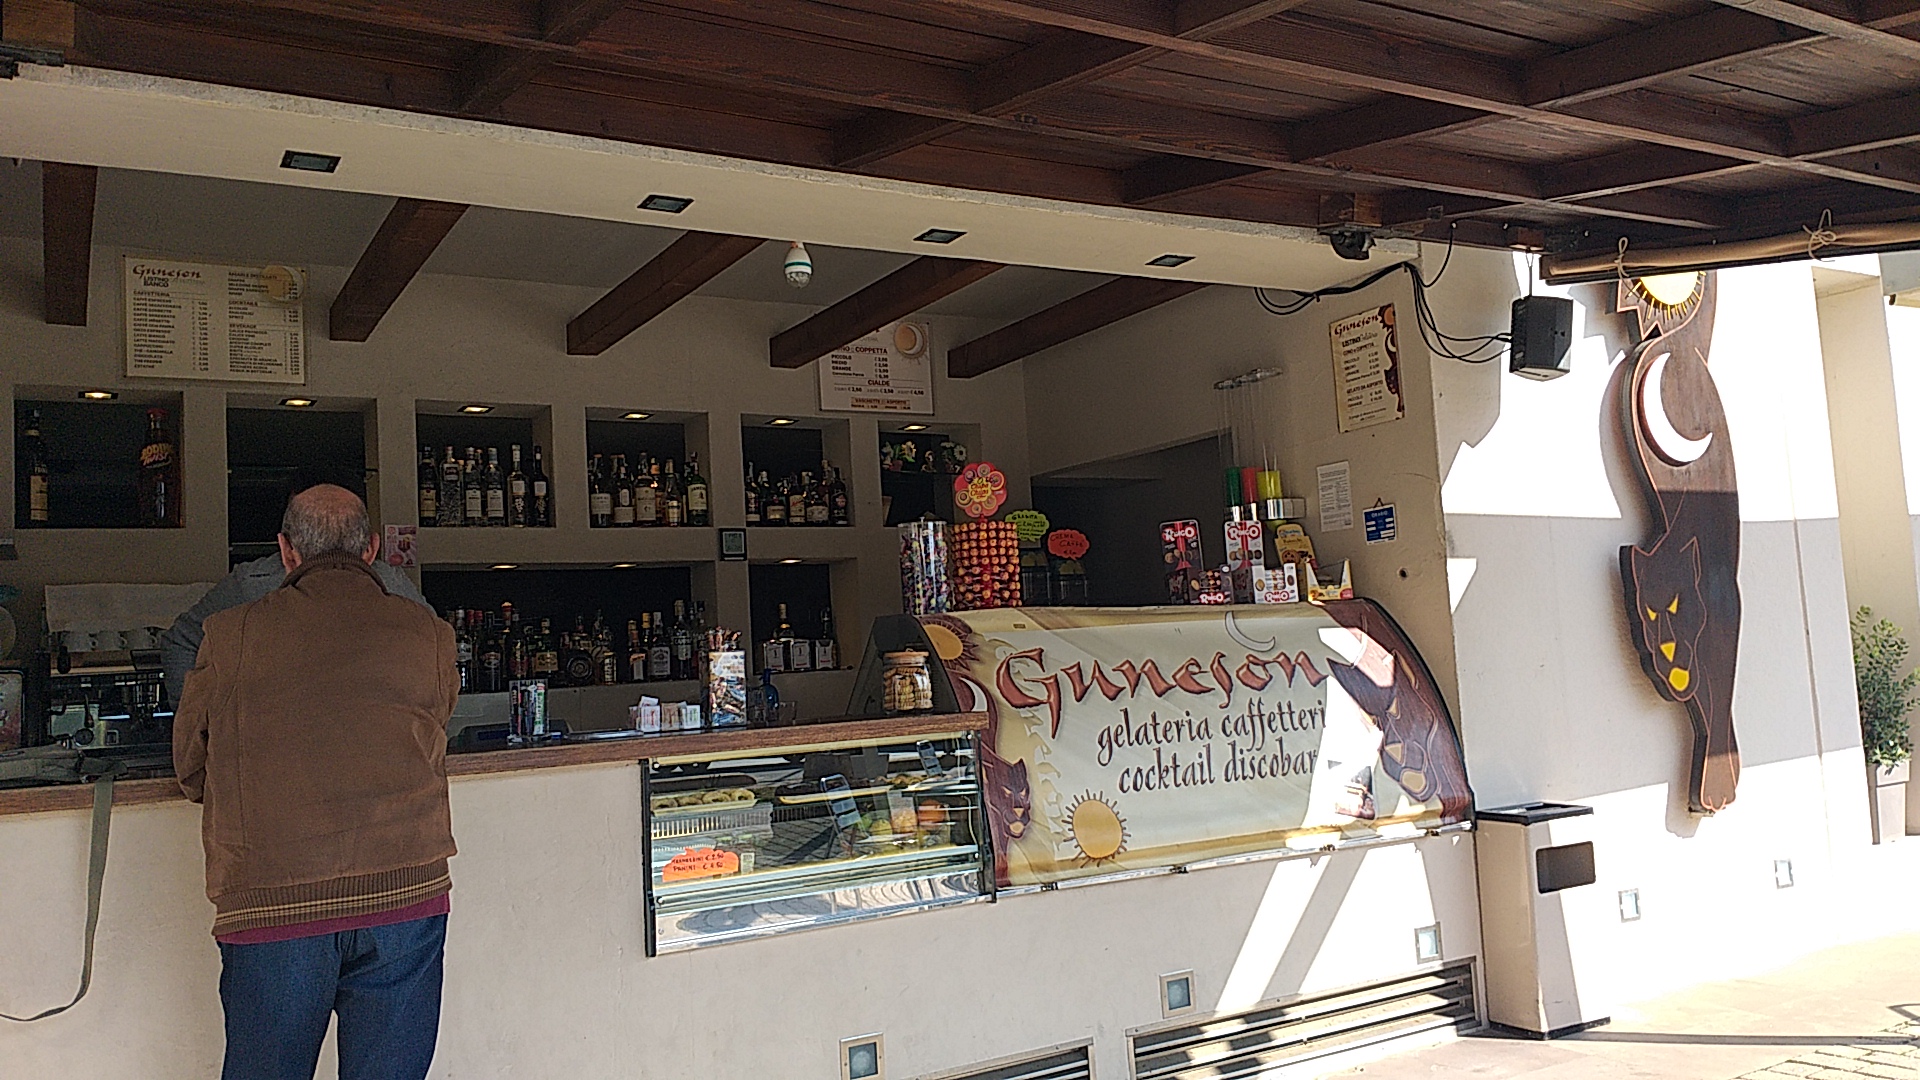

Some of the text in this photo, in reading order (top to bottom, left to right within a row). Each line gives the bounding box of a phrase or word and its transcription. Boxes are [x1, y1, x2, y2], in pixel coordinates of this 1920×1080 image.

[1342, 336, 1361, 347] LISTINO
[855, 346, 888, 354] COPPETTA
[1050, 533, 1074, 541] CREMA
[1097, 707, 1213, 767] gelateria
[1118, 736, 1319, 794] cocktail discobar
[673, 864, 696, 872] PANINI
